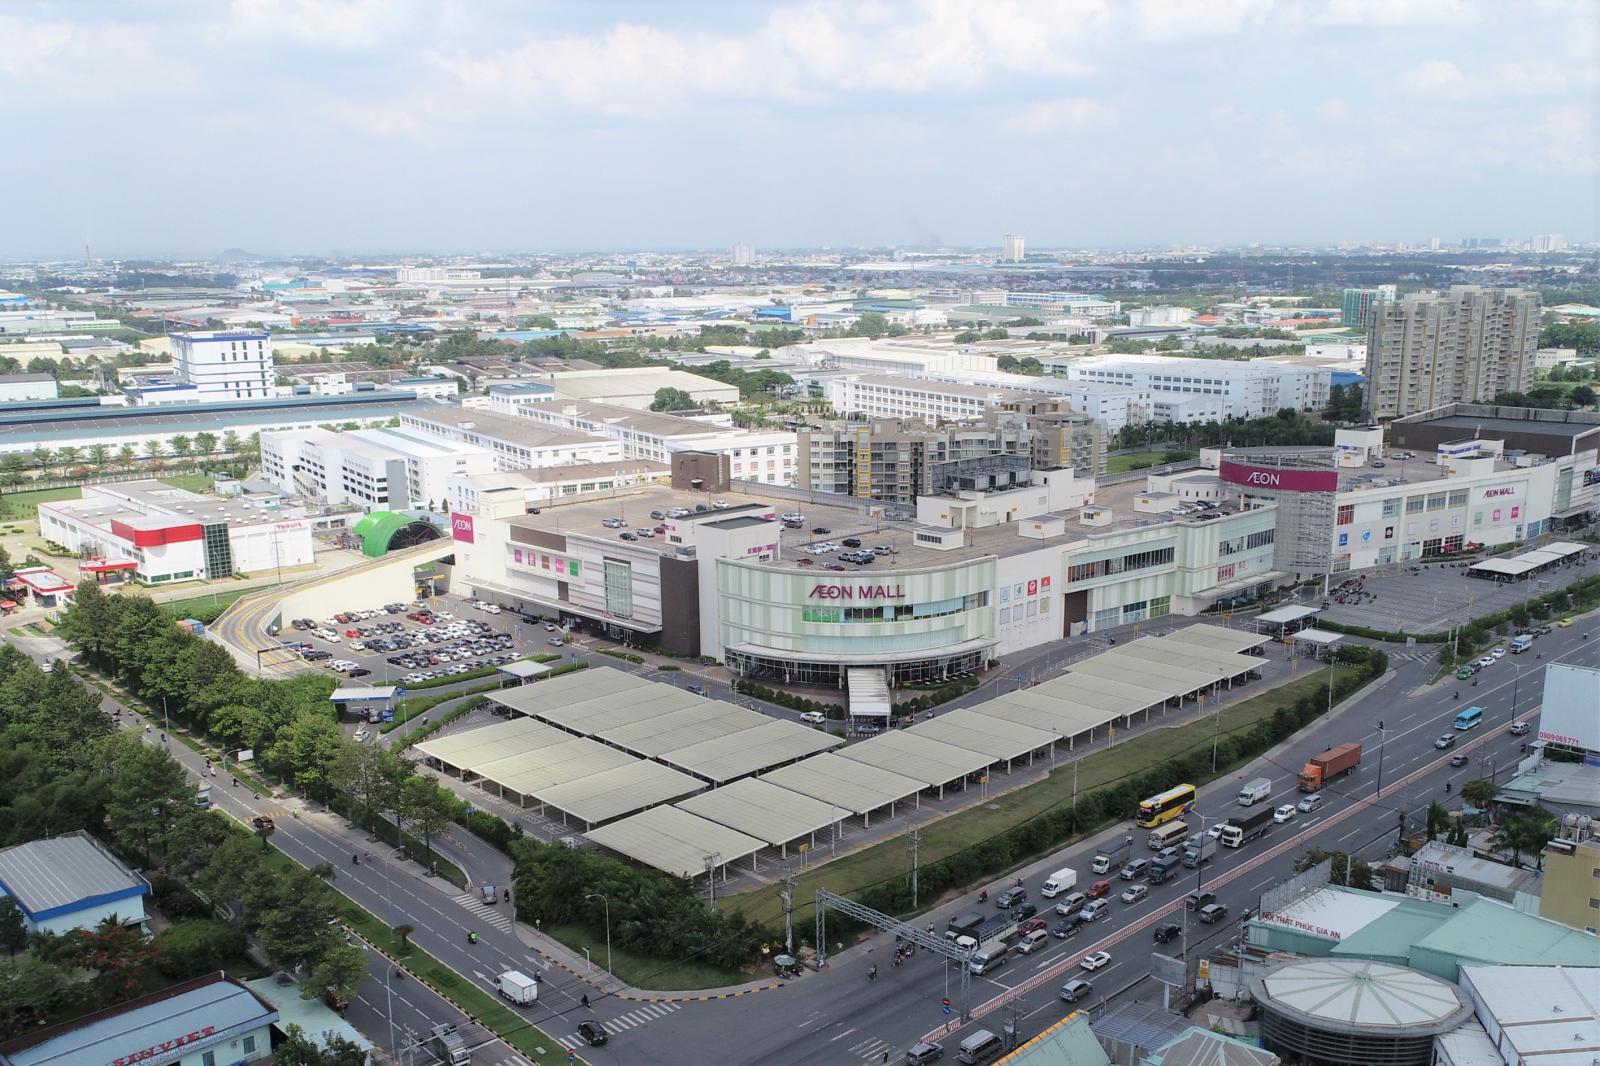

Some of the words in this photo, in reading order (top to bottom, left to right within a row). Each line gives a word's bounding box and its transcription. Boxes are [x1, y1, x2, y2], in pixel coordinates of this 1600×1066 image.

[1499, 487, 1515, 496] MALL
[858, 584, 906, 599] MALL
[1316, 926, 1328, 935] GIA
[1330, 931, 1341, 939] AN
